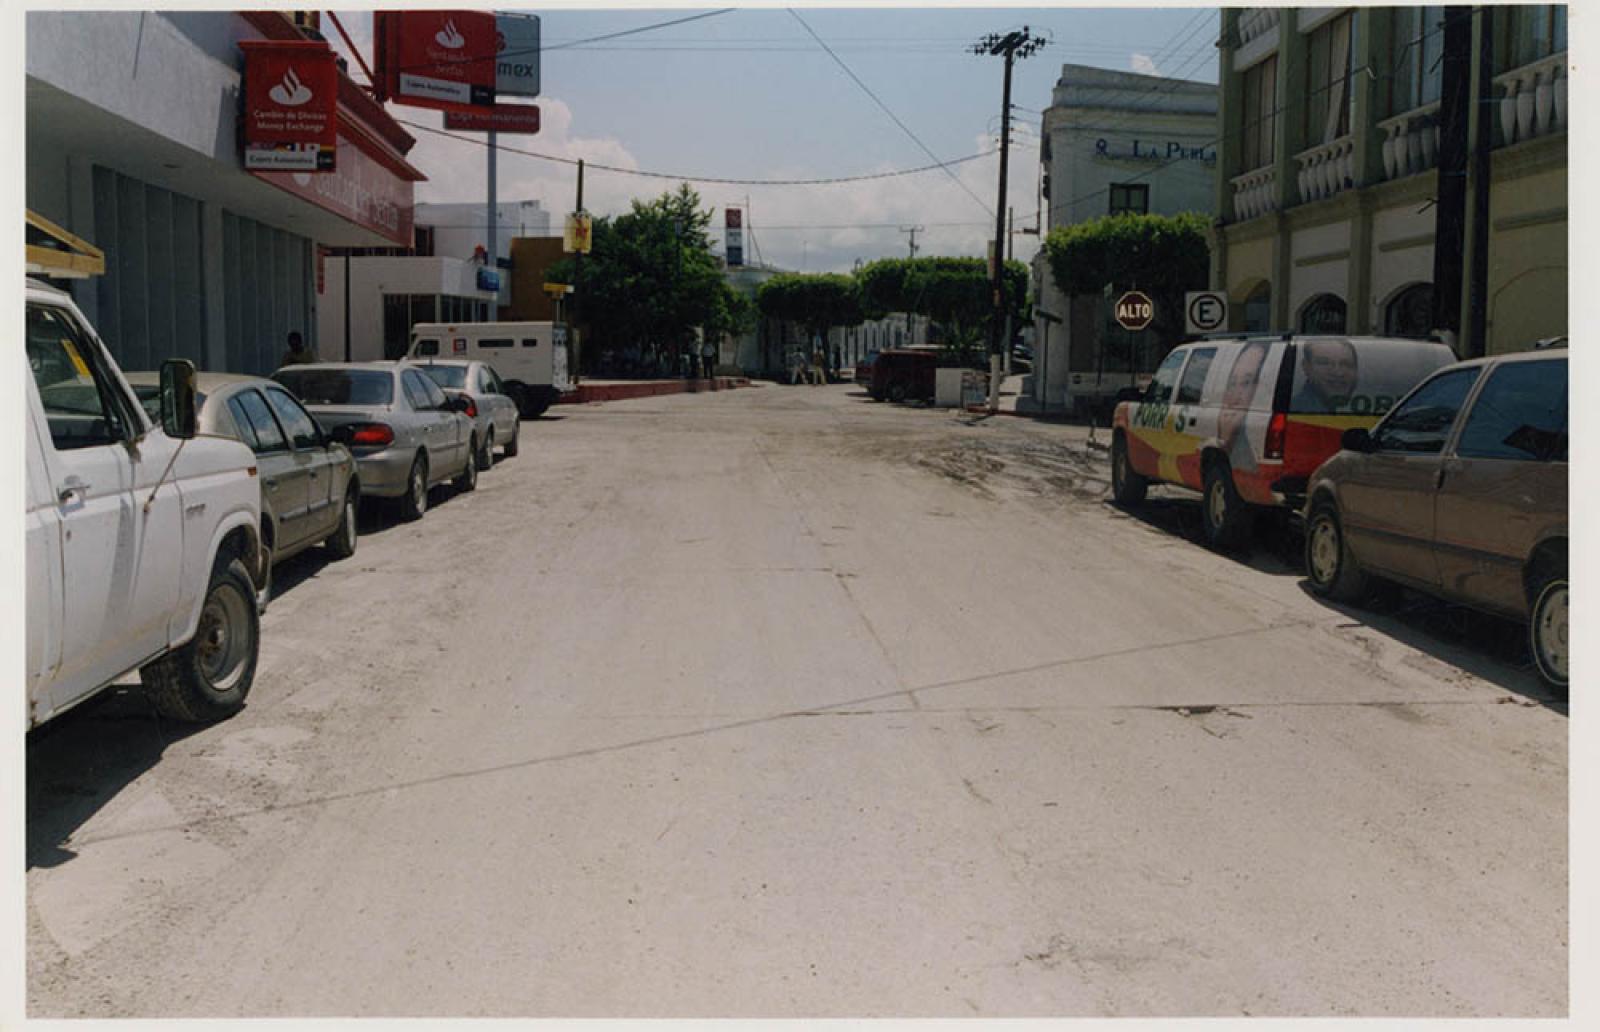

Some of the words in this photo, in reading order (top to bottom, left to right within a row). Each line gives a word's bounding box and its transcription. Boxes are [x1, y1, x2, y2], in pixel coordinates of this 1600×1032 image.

[287, 111, 297, 120] de
[257, 121, 284, 131] Money
[286, 122, 325, 133] Exchange
[1119, 303, 1150, 318] ALTO
[1199, 301, 1216, 323] E
